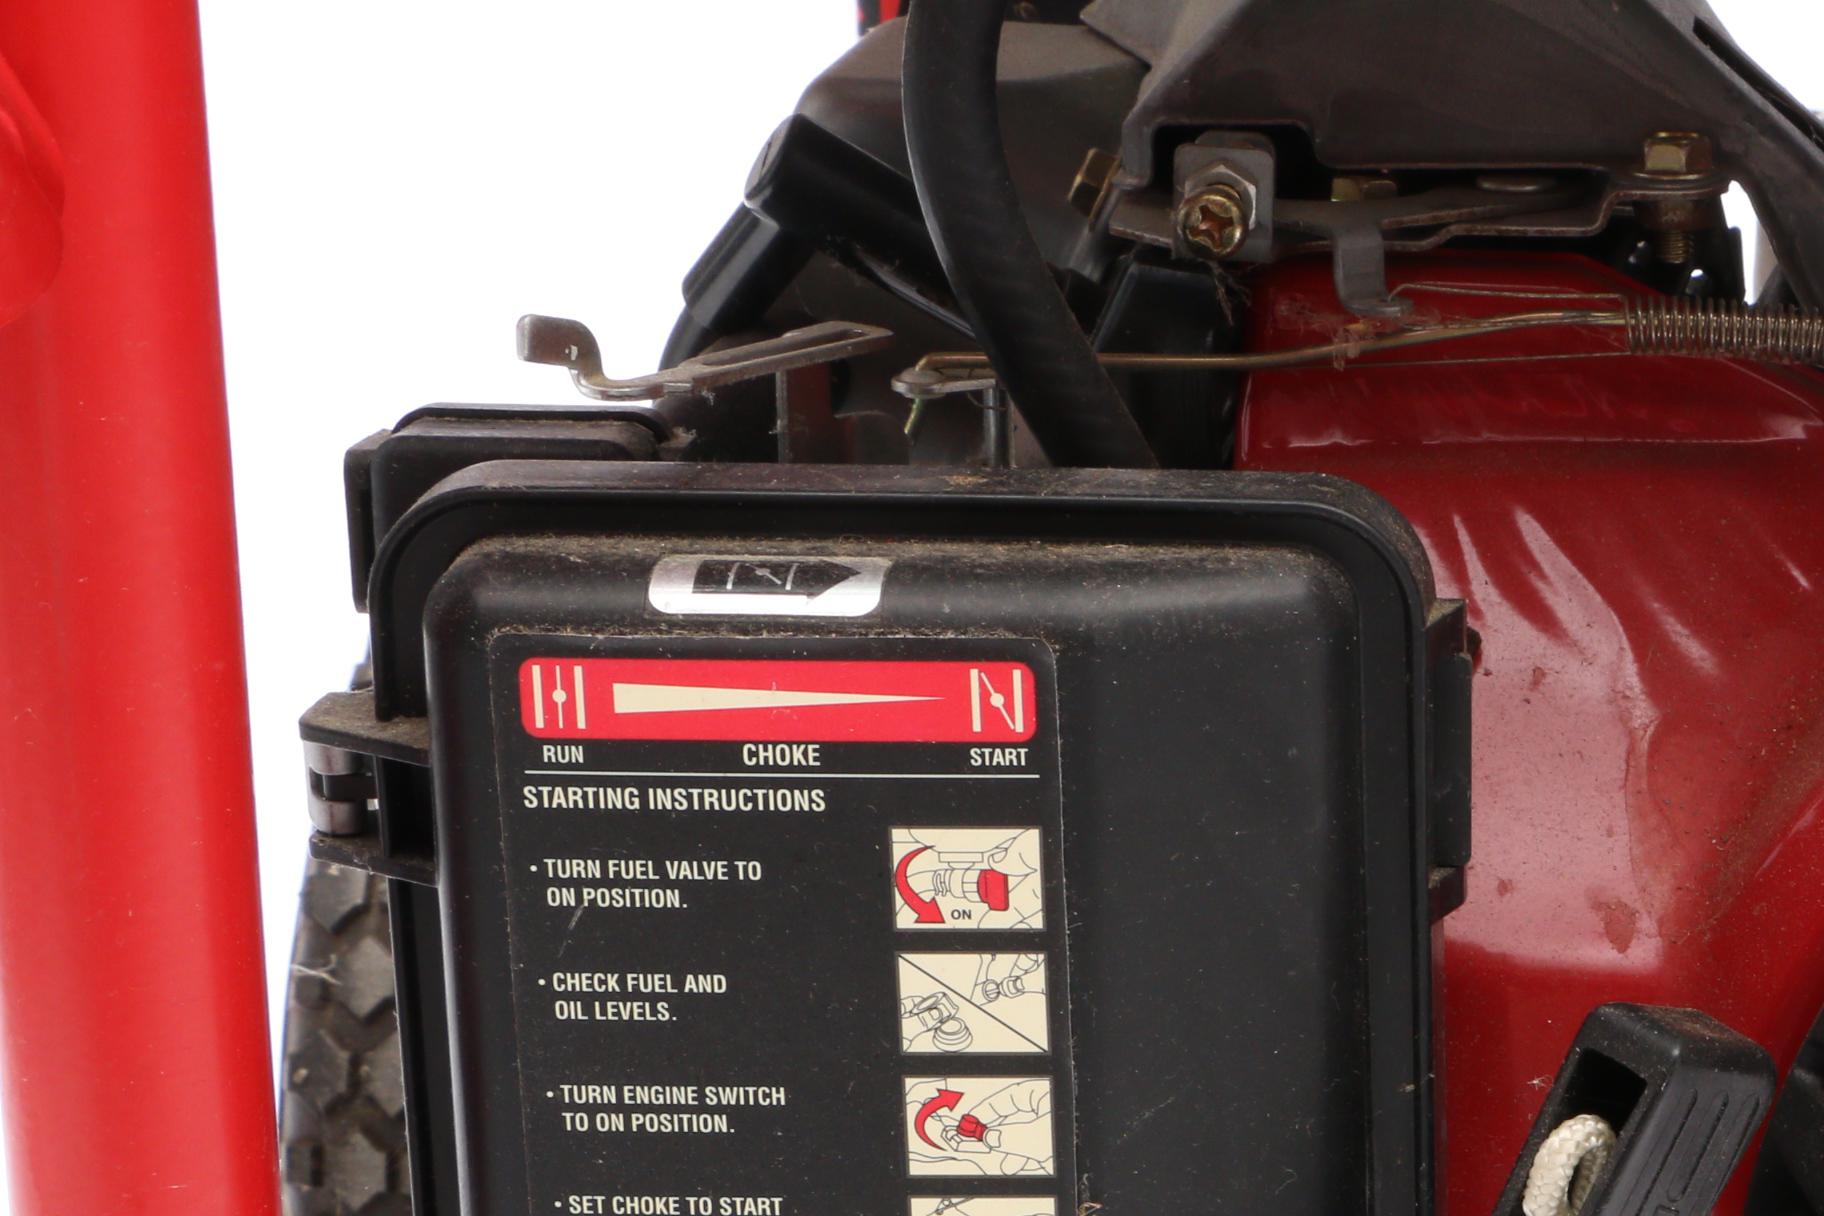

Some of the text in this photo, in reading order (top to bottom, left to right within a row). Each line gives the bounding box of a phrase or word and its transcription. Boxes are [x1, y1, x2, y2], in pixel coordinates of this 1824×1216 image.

[542, 745, 584, 764] RUN
[742, 744, 821, 766] CHOKE
[969, 748, 1029, 767] START
[523, 786, 826, 812] STARTING INSTRUCTIONS
[543, 859, 762, 881] TURN FUEL VALVE TO
[546, 887, 688, 908] ON POSITION.
[950, 909, 972, 921] ON
[552, 973, 727, 994] CHECK FUEL AND
[554, 1001, 677, 1021] OIL LEVELS.
[559, 1085, 786, 1106] TURN ENGINE SWITCH
[561, 1113, 735, 1133] TO ON POSITION.
[568, 1196, 783, 1216] SET CHOKE TO START
